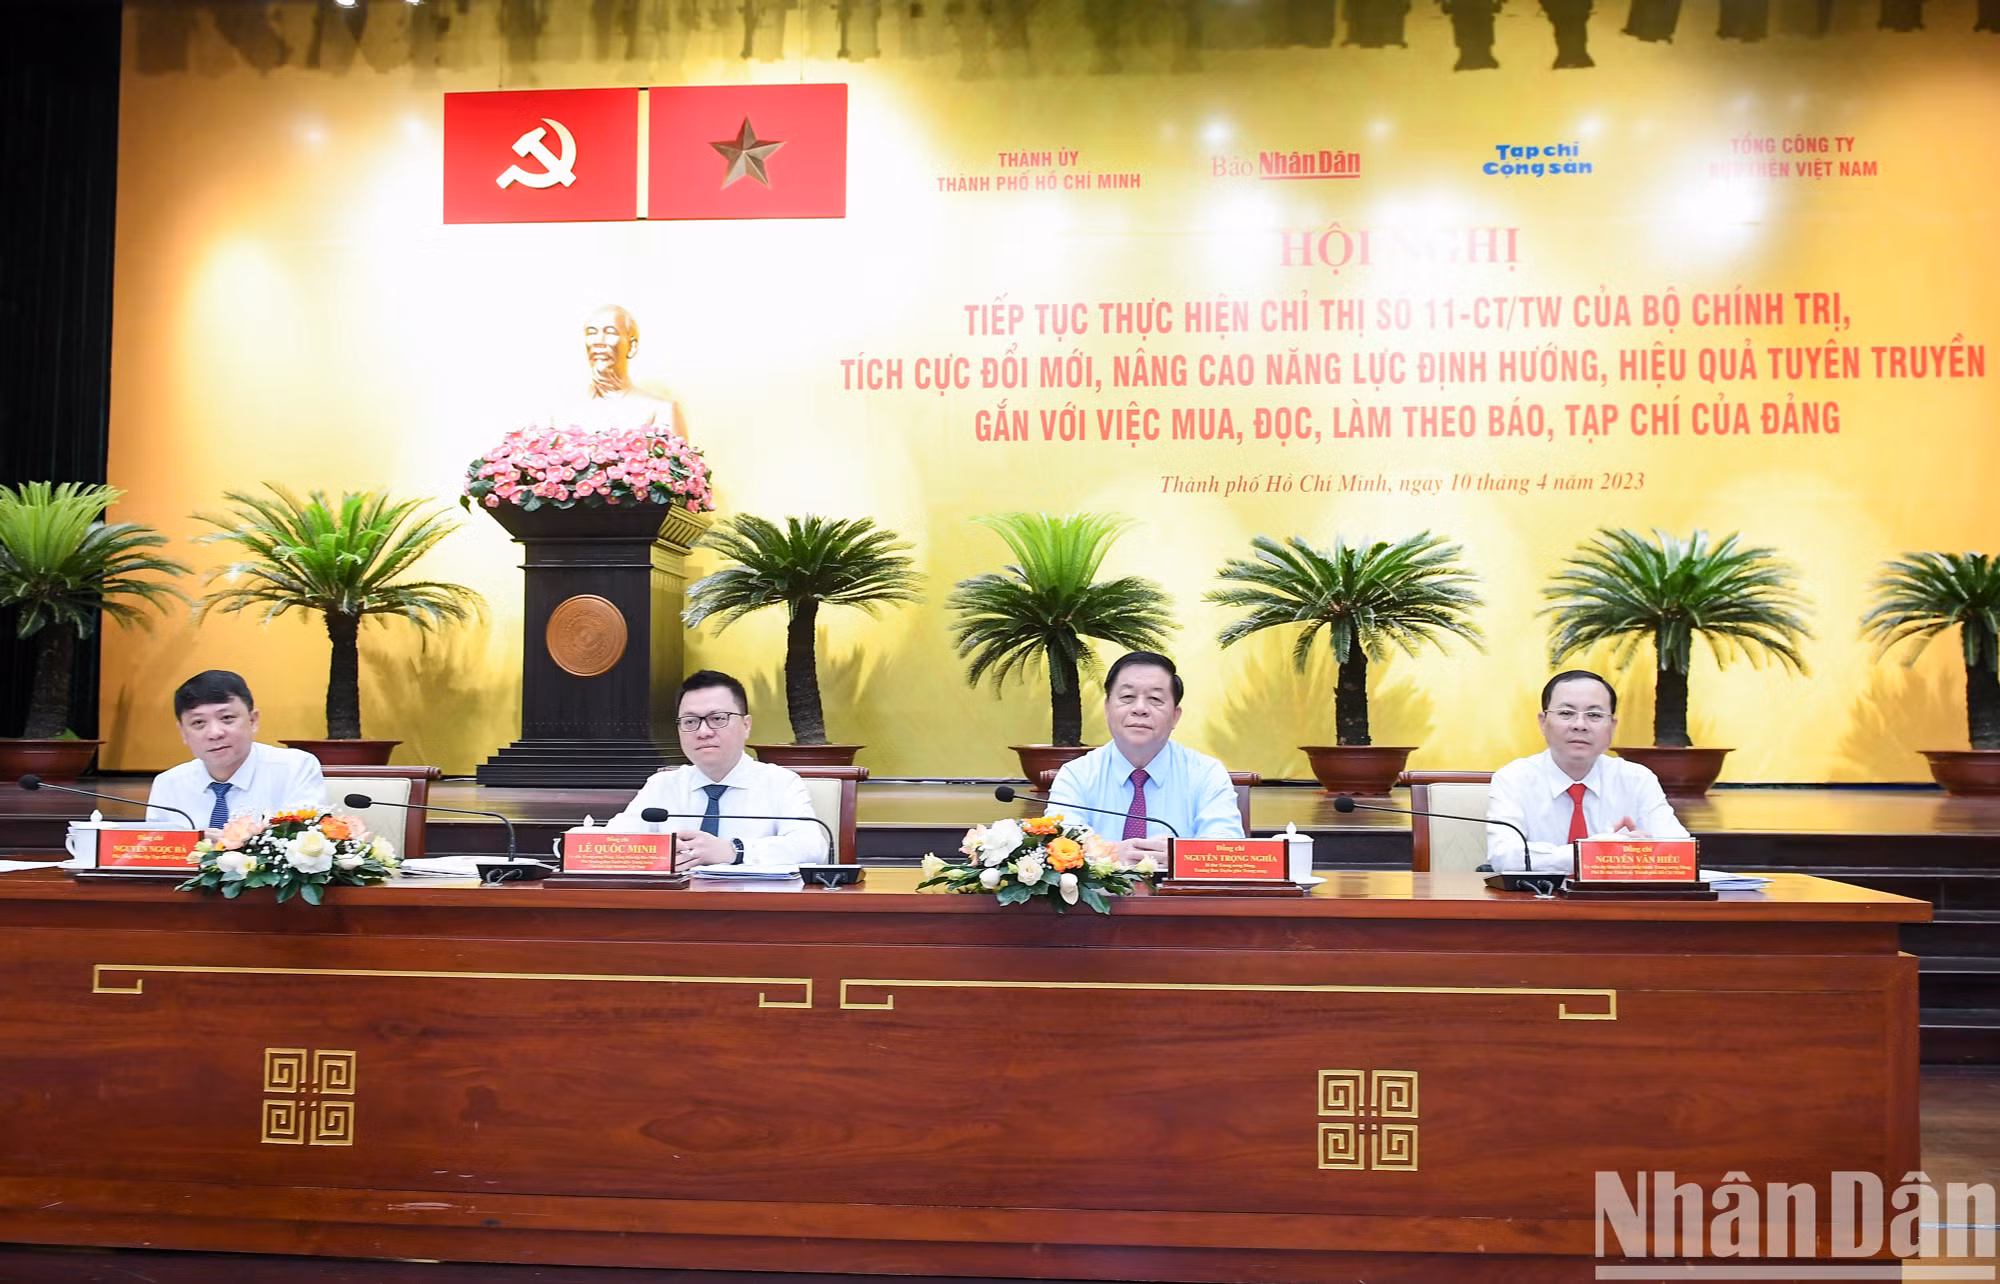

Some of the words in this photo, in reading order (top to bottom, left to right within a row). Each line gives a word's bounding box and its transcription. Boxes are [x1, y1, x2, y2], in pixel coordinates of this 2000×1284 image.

[1496, 143, 1539, 161] Tạp
[1782, 133, 1829, 153] CÔNG
[1835, 137, 1855, 152] TY
[999, 149, 1051, 167] THÀNH
[1058, 146, 1079, 166] ỦY
[1259, 151, 1315, 175] Nhân
[1319, 150, 1360, 173] Dân
[1796, 157, 1833, 180] VIỆT
[1839, 161, 1877, 176] NAM
[937, 173, 990, 191] THÀNH
[997, 170, 1030, 191] PHỐ
[1064, 171, 1092, 189] CHÍ
[1098, 174, 1141, 189] MINH
[1280, 222, 1373, 275] HỘI
[1391, 226, 1521, 273] HỊ
[964, 292, 1025, 336] TIẾP
[1035, 301, 1088, 342] TỤC
[1099, 297, 1173, 340] THỰC
[1185, 293, 1249, 339] HIỆN
[1261, 290, 1309, 333] CHỈ
[1319, 298, 1365, 338] THỊ
[1424, 295, 1562, 332] 11-CT/TW
[1573, 285, 1631, 329] CỦA
[1642, 287, 1681, 333] BỘ
[1692, 285, 1784, 328] CHÍNH
[1794, 292, 1851, 332] TRỊ,
[841, 352, 903, 390] TÍCH
[914, 353, 970, 396] CỰC
[981, 342, 1028, 389] ĐỔI
[1040, 348, 1102, 393] MỚI,
[1113, 348, 1187, 388] NÂNG
[1199, 353, 1255, 387] CAO
[1265, 348, 1341, 386] NĂNG
[1353, 347, 1406, 391] LỰC
[1417, 351, 1487, 391] ĐỊNH
[1498, 342, 1607, 388] HƯỚNG,
[1619, 341, 1687, 388] HIỆU
[1699, 339, 1758, 383] QUẢ
[1768, 340, 1860, 380] TUYÊN
[1871, 333, 1986, 379] TRUYỀN
[975, 398, 1029, 442] GẮN
[1039, 401, 1086, 442] VỚI
[1096, 401, 1160, 447] VIỆC
[1172, 407, 1243, 445] MUA,
[1253, 407, 1322, 447] ĐỌC,
[1333, 397, 1392, 438] LÀM
[1402, 404, 1476, 437] THEO
[1488, 397, 1554, 442] BÁO,
[1564, 404, 1619, 443] TẠP
[1630, 396, 1680, 435] CHÍ
[1691, 392, 1750, 435] CỦA
[1760, 392, 1840, 435] ĐẢNG
[1161, 475, 1219, 493] Thành
[1224, 474, 1261, 497] phố
[1266, 473, 1293, 493] Hồ
[1299, 474, 1332, 493] Chí
[1338, 474, 1392, 494] Minh,
[1451, 473, 1471, 491] 10
[1477, 473, 1530, 495] tháng
[1536, 473, 1548, 490] 4
[1553, 474, 1593, 490] năm
[1600, 472, 1645, 490] 2023
[578, 842, 592, 853] LÊ
[594, 842, 625, 854] QUỐC
[628, 844, 656, 853] MINH
[1220, 854, 1249, 863] TRỌNG
[1636, 854, 1656, 863] VĂN
